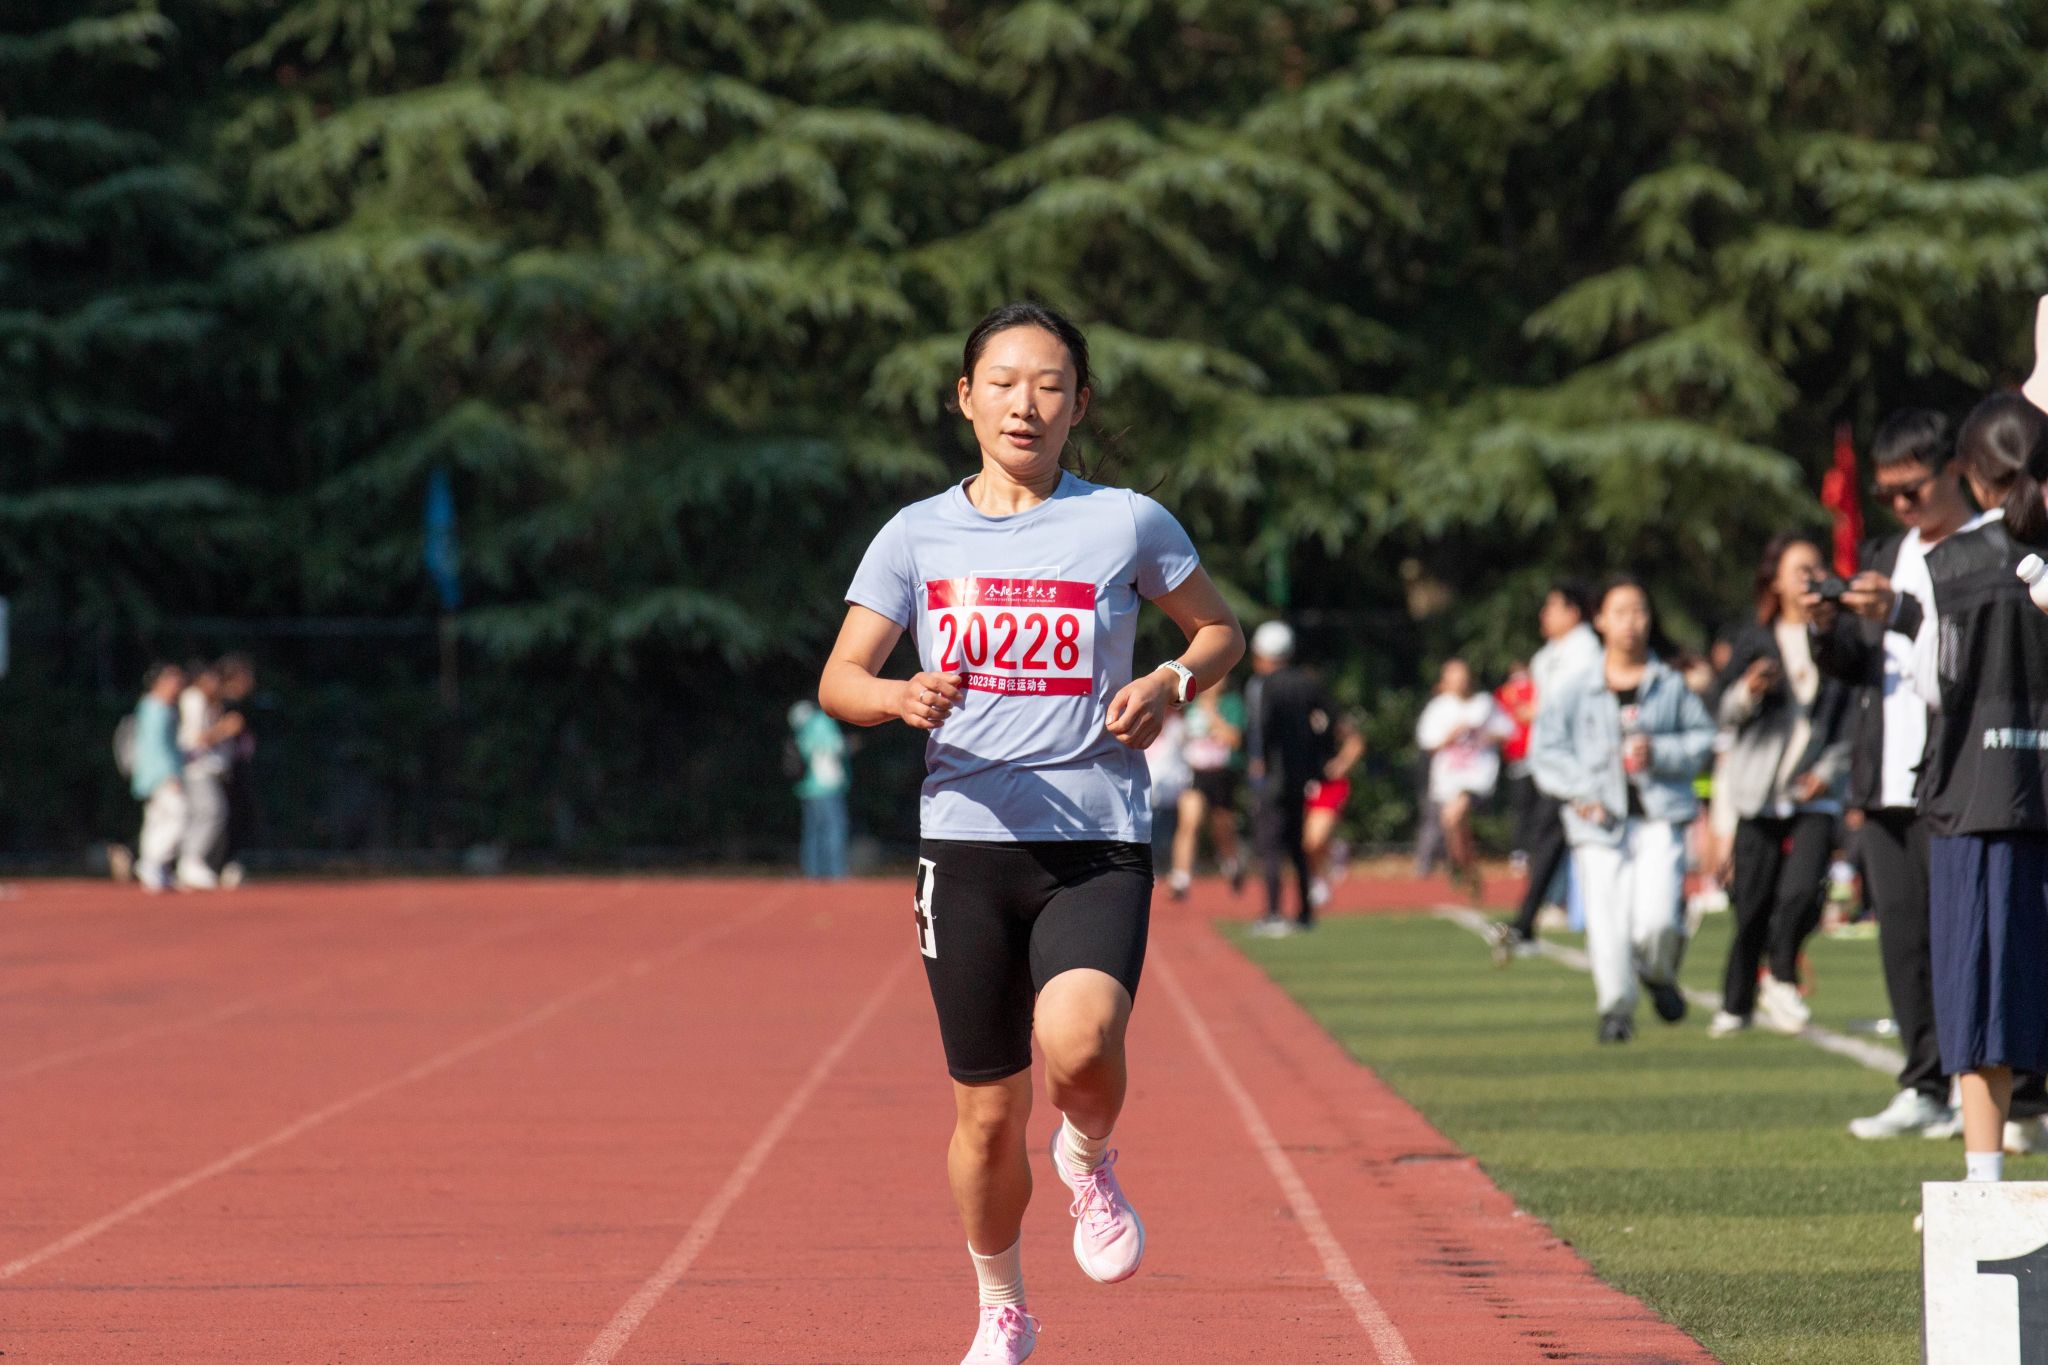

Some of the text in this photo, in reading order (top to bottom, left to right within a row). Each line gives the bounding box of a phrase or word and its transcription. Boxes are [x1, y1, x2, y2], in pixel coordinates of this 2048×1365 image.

[939, 612, 1080, 672] 20228
[968, 674, 1047, 692] 2023年田径运动会
